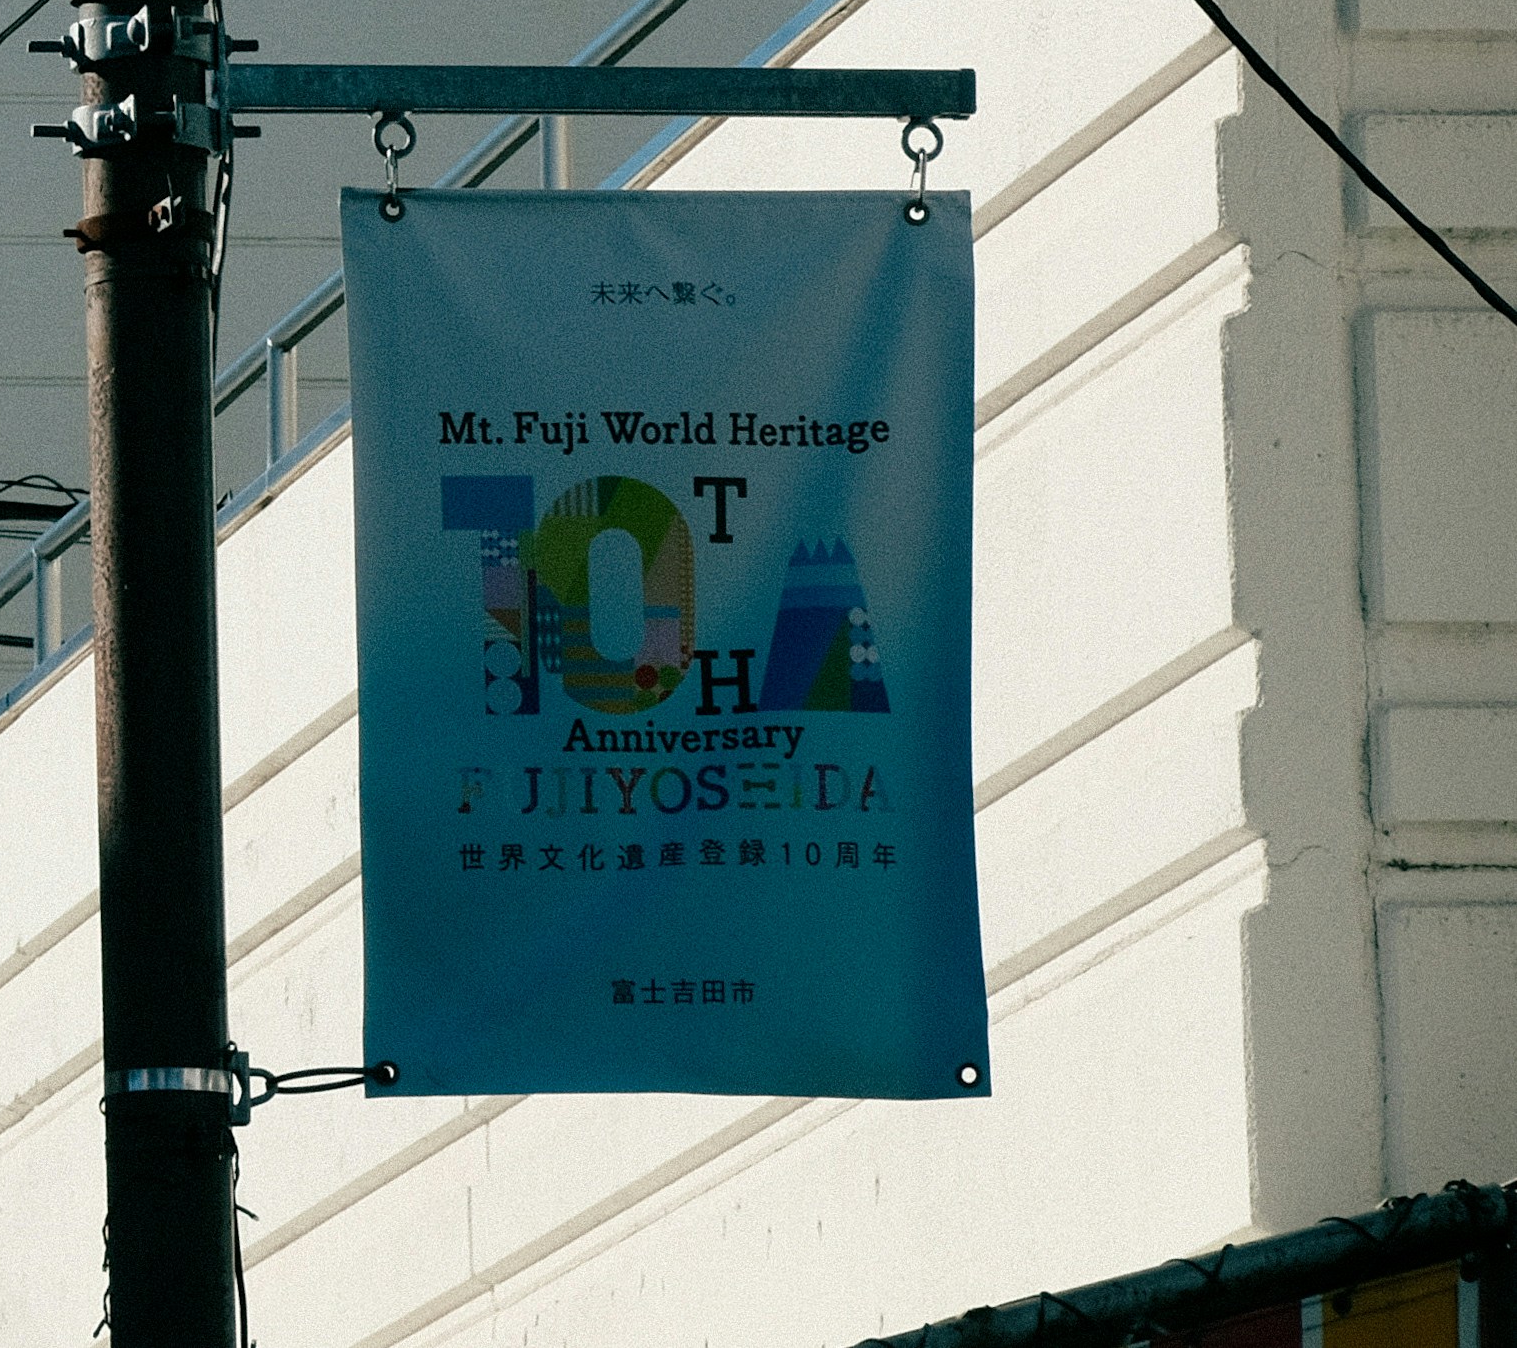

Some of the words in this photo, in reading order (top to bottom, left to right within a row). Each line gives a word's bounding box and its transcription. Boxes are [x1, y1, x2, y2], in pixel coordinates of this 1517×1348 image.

[439, 411, 503, 445] Mt.
[513, 411, 589, 456] Fuji
[601, 411, 716, 446] World
[729, 412, 890, 455] Heritage
[562, 718, 805, 759] Anniversary
[611, 978, 756, 1004] 富士吉田市
